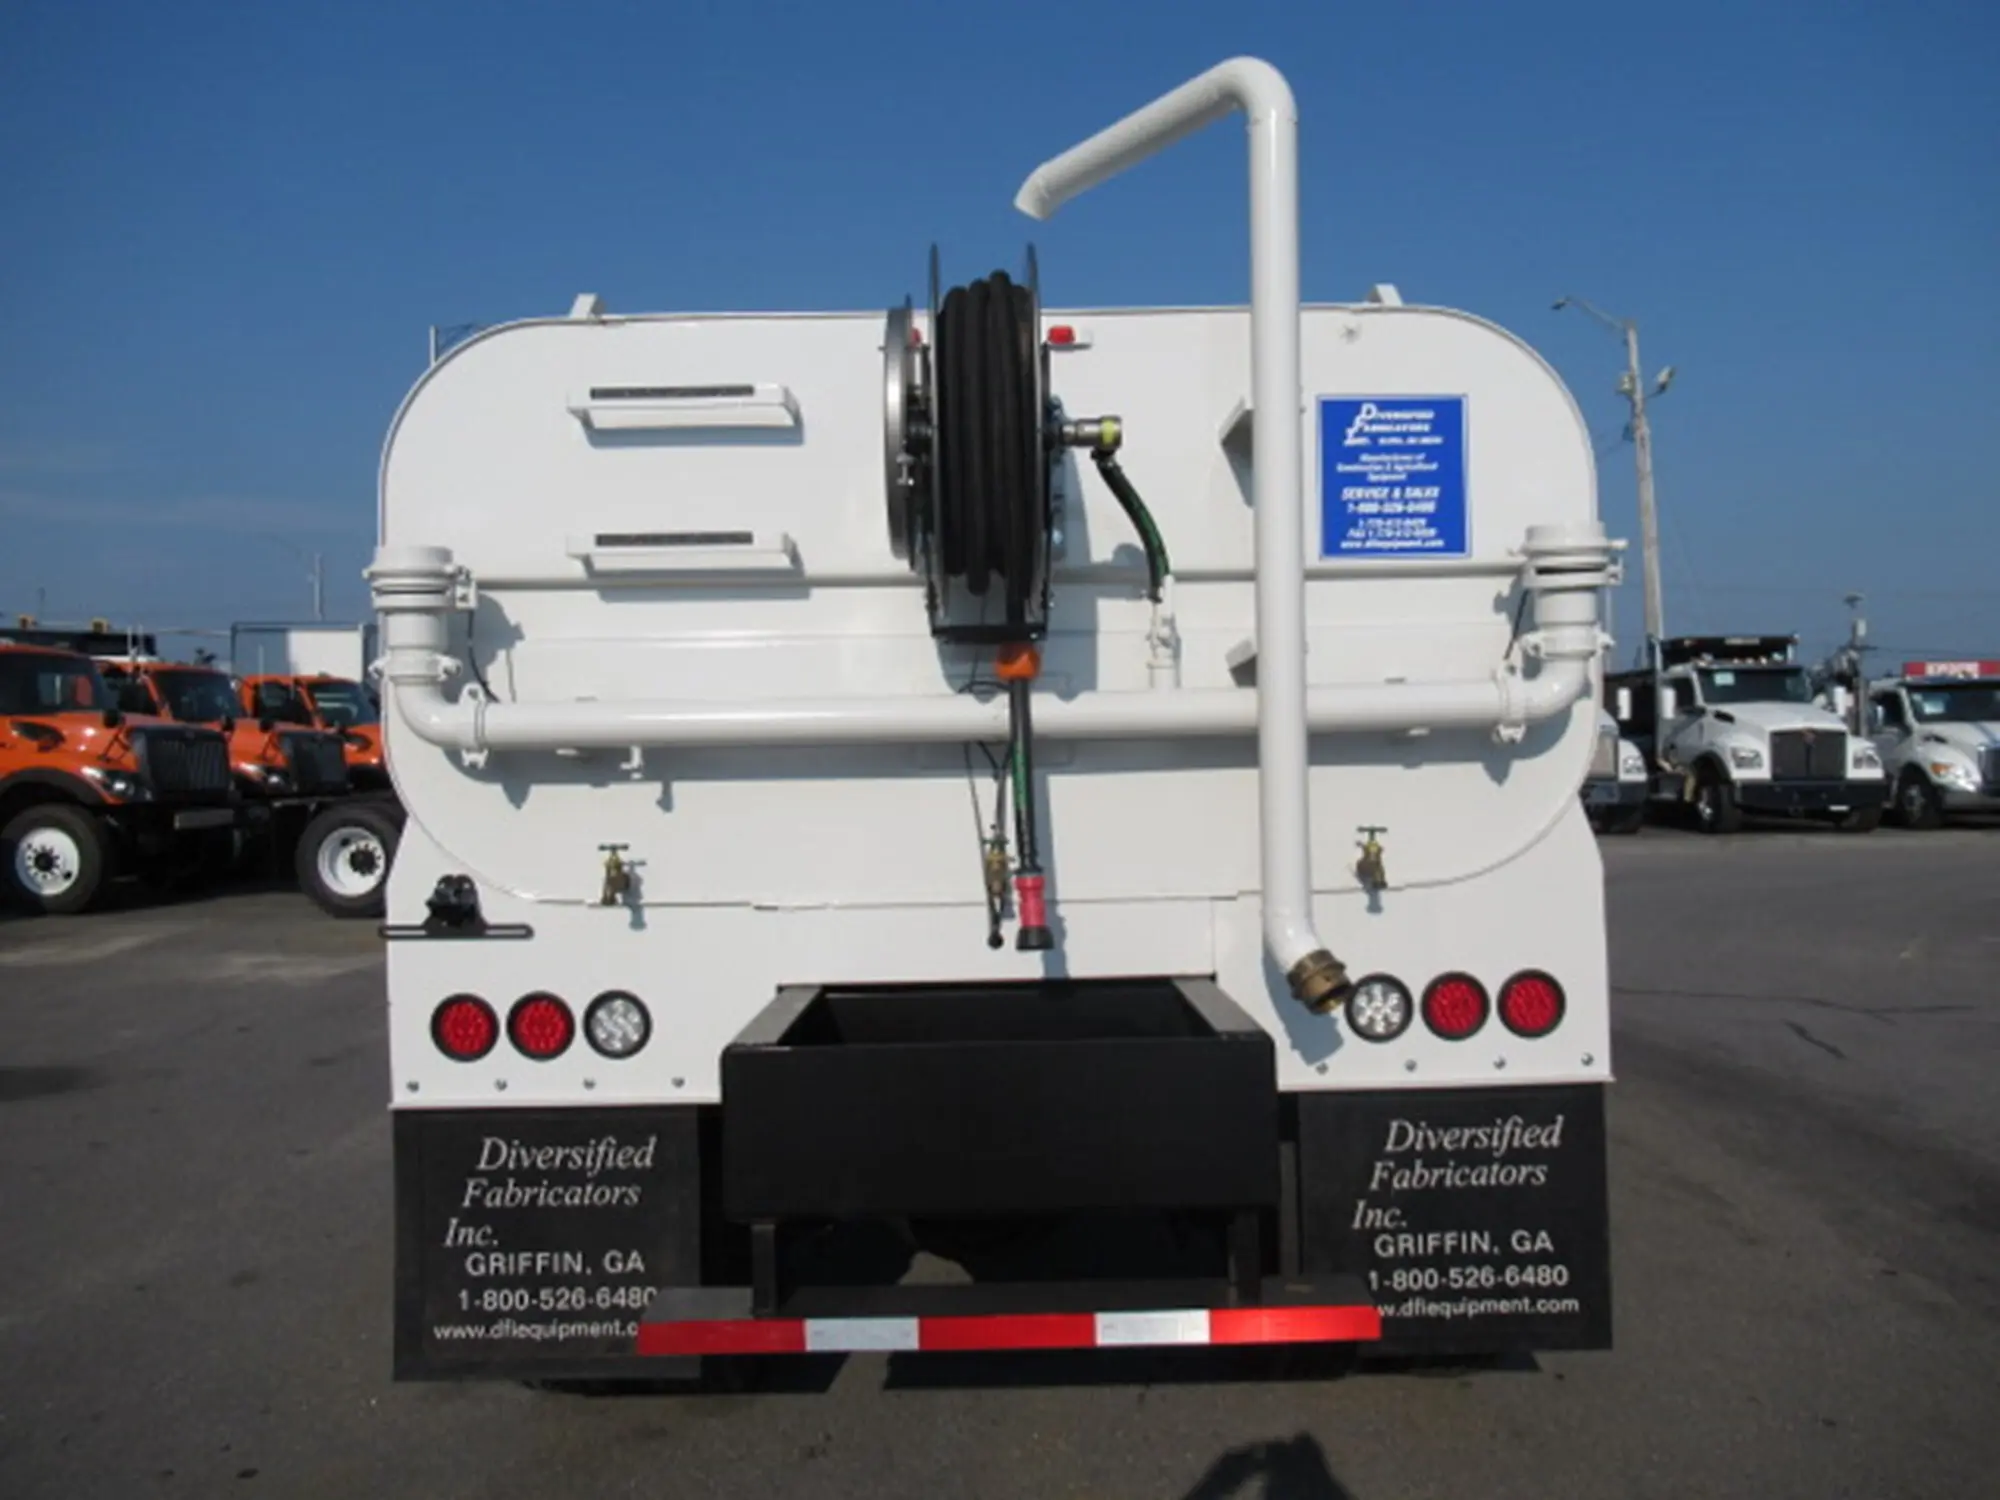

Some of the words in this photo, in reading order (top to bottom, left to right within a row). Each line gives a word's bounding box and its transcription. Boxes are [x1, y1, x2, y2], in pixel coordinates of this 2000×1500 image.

[1384, 1114, 1564, 1158] Diversified
[476, 1133, 657, 1178] Diversified
[1369, 1159, 1548, 1191] Fabricators
[462, 1177, 642, 1208] Fabricators
[1352, 1200, 1408, 1230] Inc.
[443, 1217, 499, 1248] Inc.
[1374, 1231, 1500, 1258] GRIFFIN,
[1510, 1229, 1554, 1253] GA
[465, 1251, 592, 1277] GRIFFIN,
[603, 1249, 645, 1274] GA
[1368, 1264, 1570, 1291] 1-800-526-6480
[1377, 1297, 1579, 1320] w.dfiequipment.com
[433, 1318, 639, 1341] www.dfiequipment.c
